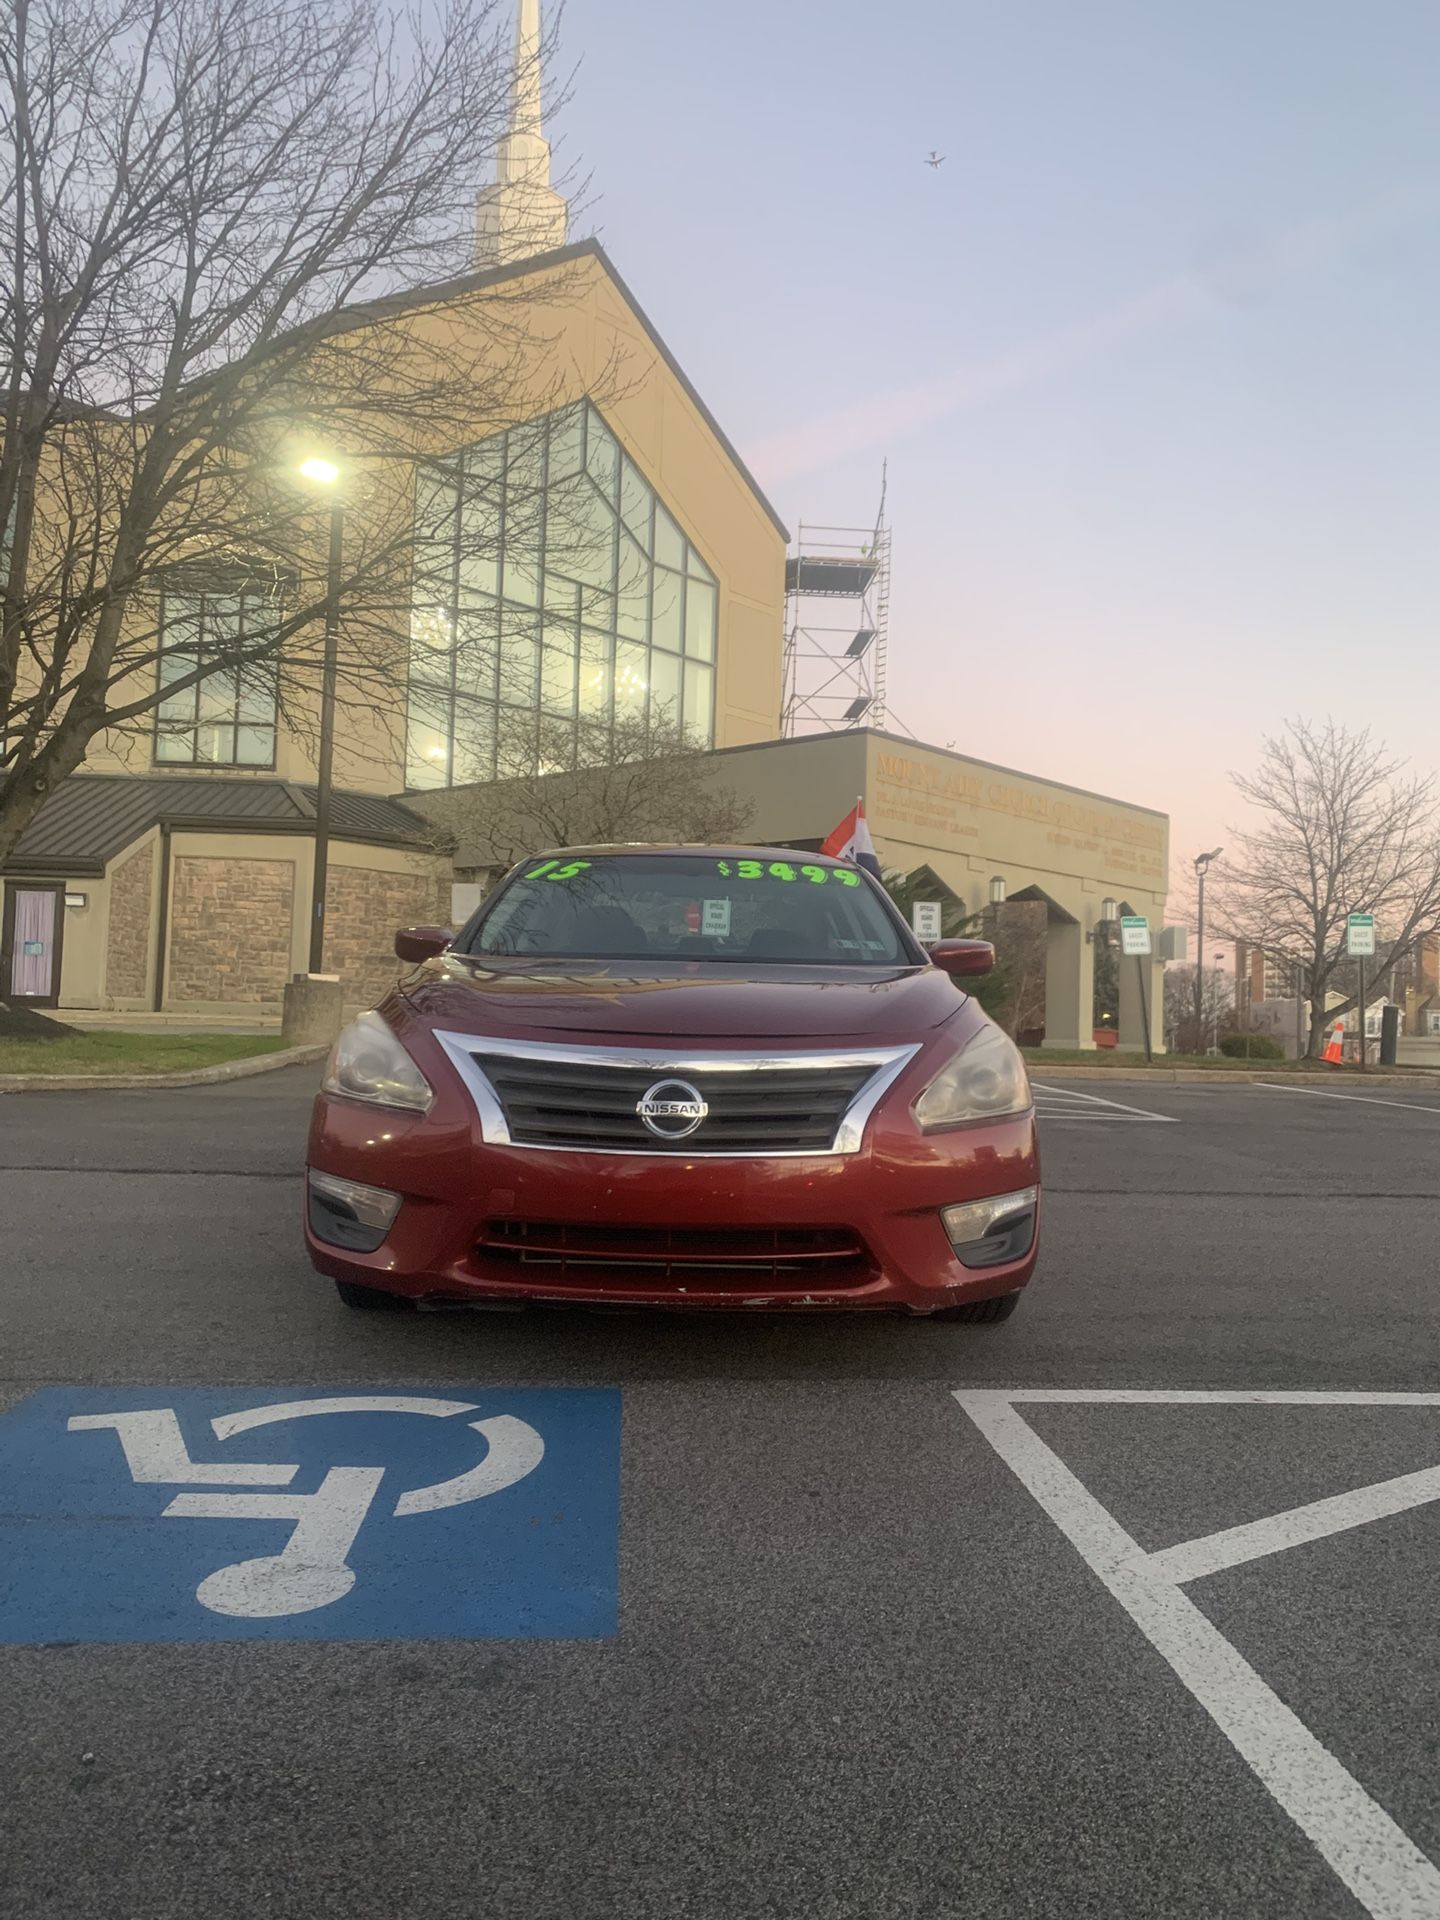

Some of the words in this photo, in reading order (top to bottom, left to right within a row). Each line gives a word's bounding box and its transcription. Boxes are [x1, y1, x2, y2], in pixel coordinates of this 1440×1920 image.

[524, 861, 592, 880] 15
[717, 861, 861, 887] $3499
[645, 1104, 700, 1114] NISSAN
